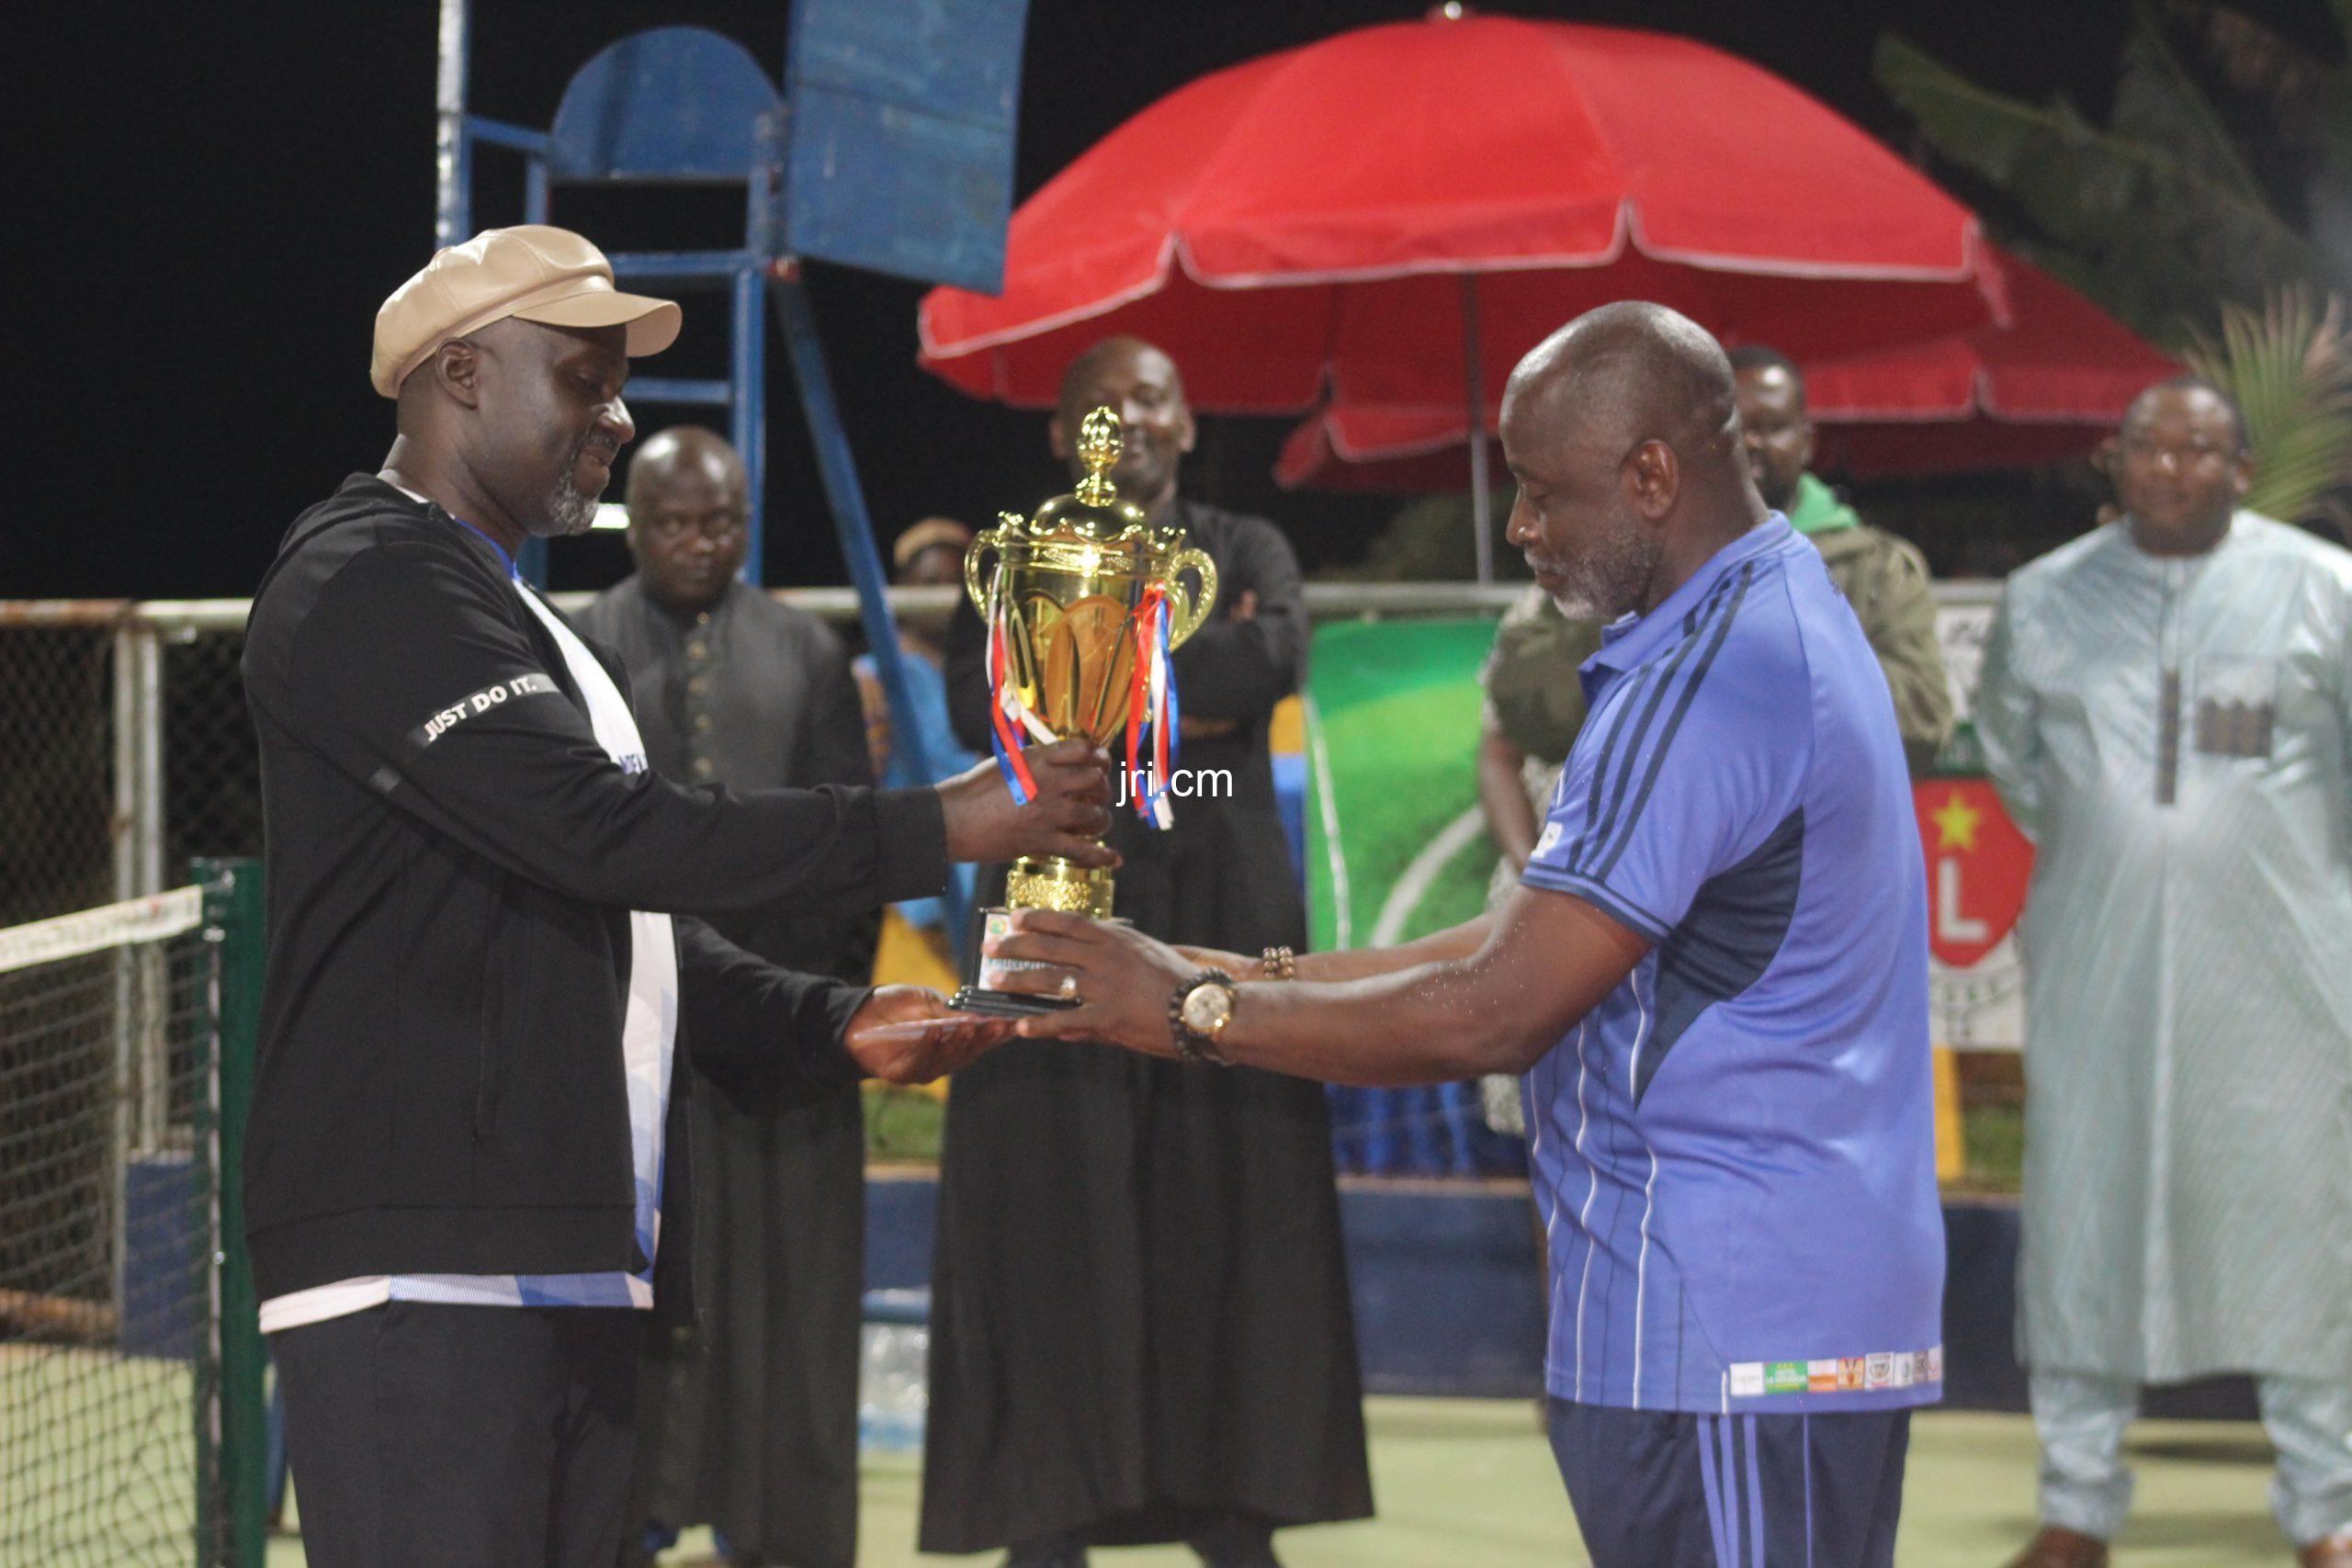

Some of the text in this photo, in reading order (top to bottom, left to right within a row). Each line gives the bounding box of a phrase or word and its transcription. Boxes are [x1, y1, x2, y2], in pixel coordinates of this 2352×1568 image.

[424, 676, 537, 741] JUST DO IT.
[1937, 856, 1987, 942] L
